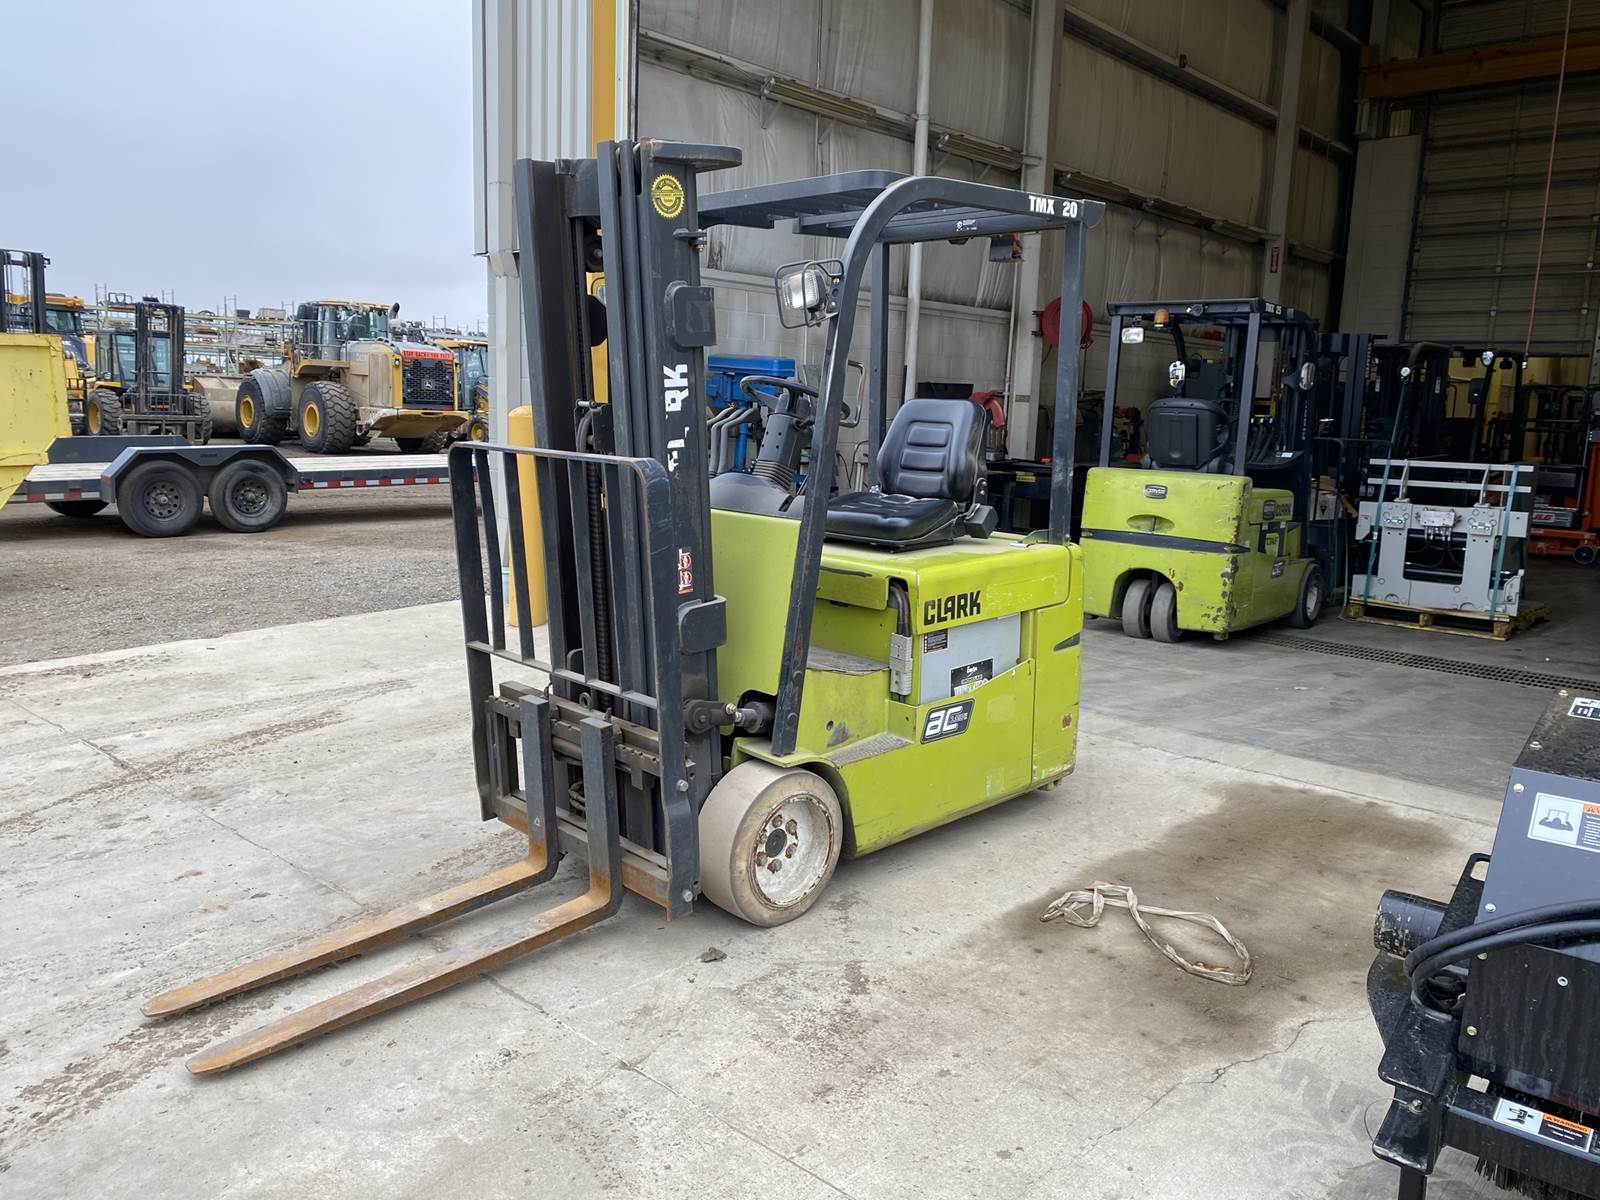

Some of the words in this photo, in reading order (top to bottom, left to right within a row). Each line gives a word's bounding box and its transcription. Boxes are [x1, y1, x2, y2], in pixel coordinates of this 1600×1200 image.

[1028, 195, 1055, 215] TMX
[1062, 201, 1078, 218] 20
[923, 590, 981, 626] CLARK
